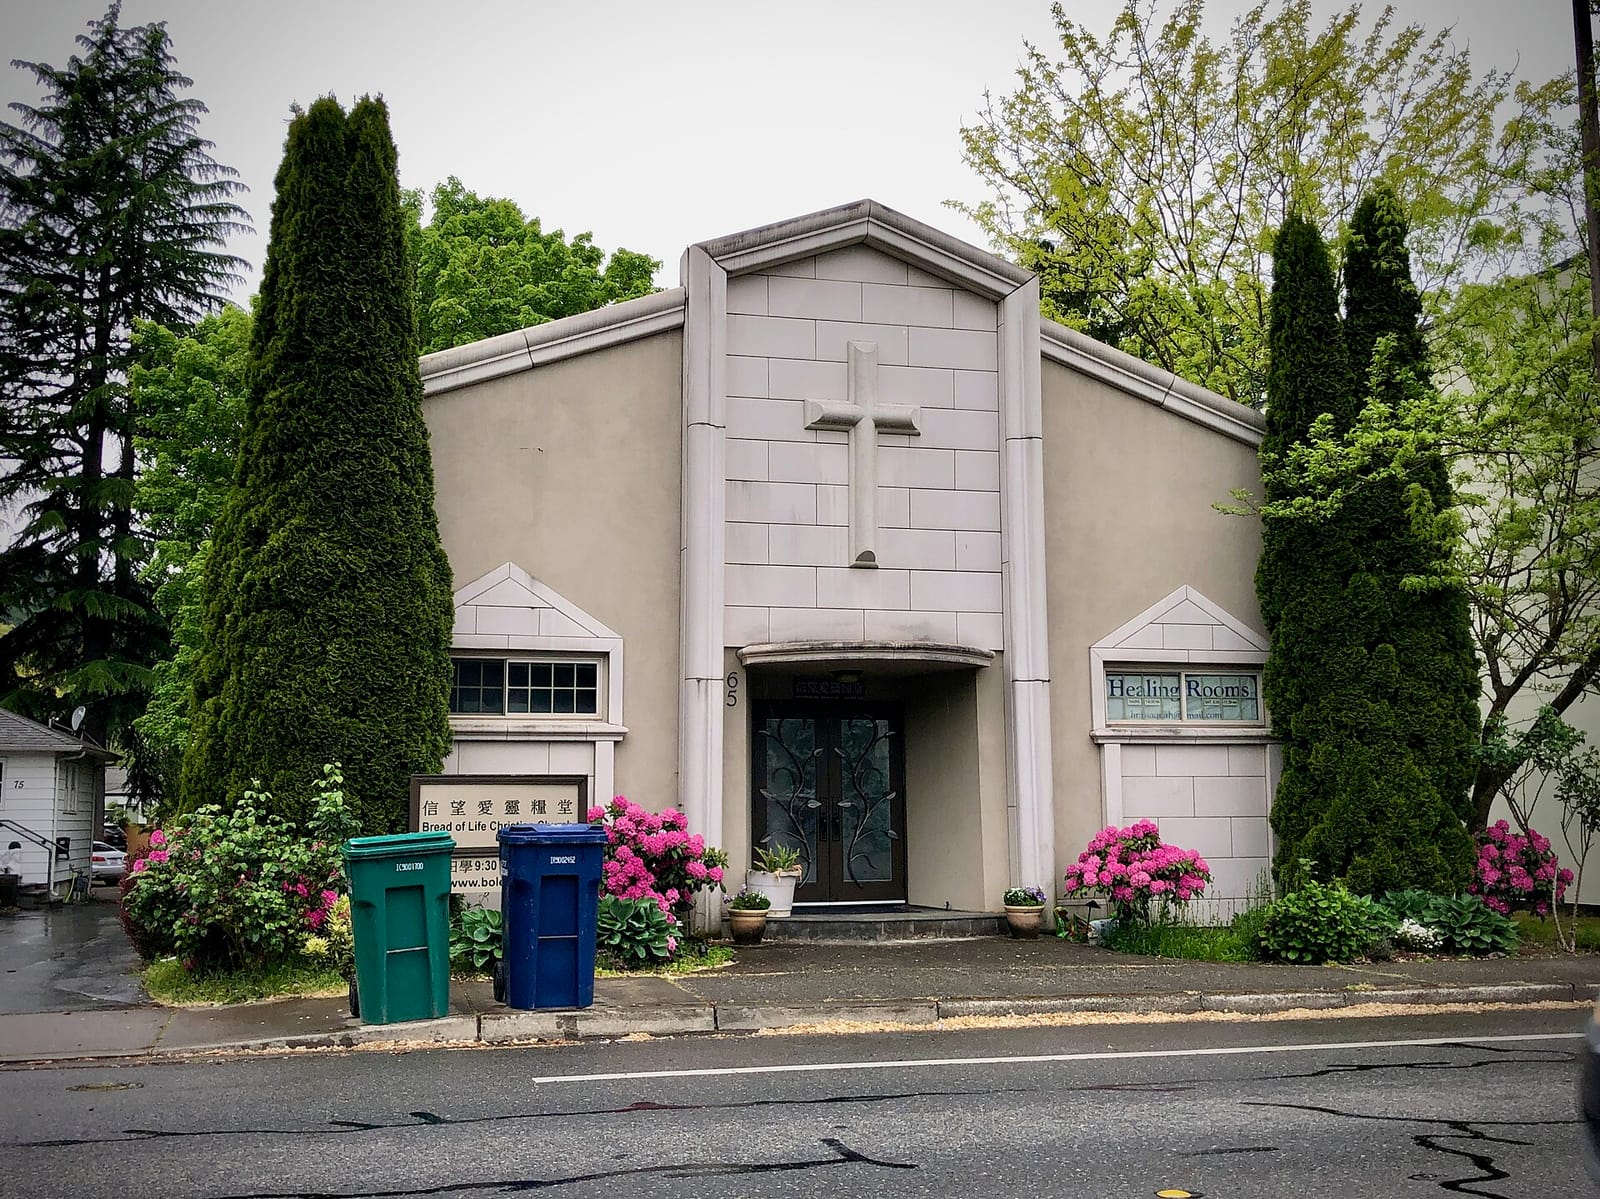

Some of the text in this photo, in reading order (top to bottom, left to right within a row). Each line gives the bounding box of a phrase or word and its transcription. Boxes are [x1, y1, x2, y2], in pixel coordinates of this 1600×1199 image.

[726, 671, 738, 707] 65
[1108, 679, 1250, 702] Healing Rooms
[13, 780, 25, 789] 75
[422, 799, 573, 817] 信望愛靈糧堂
[422, 821, 452, 832] Bread
[455, 821, 466, 831] of
[468, 821, 487, 831] Life
[474, 860, 497, 871] 9:30
